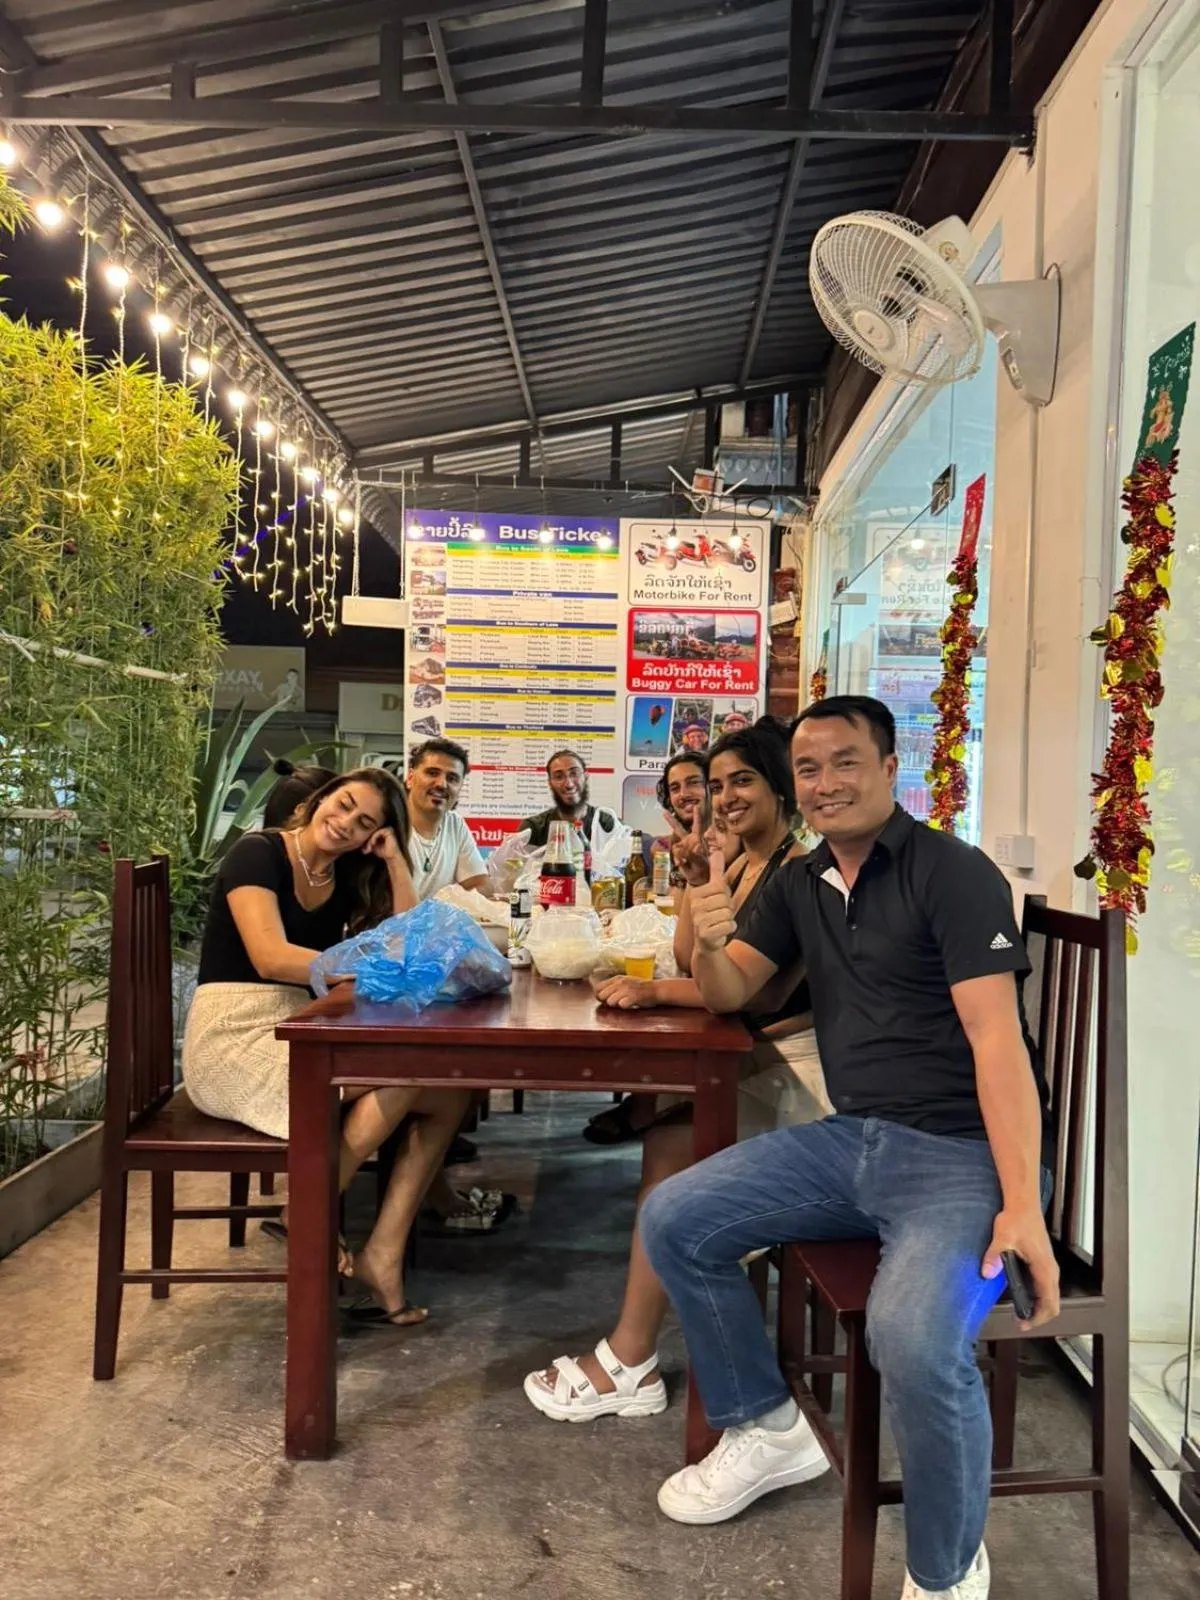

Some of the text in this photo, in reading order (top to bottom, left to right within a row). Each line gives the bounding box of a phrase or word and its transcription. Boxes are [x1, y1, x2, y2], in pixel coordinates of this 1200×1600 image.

[499, 525, 540, 540] Bus
[633, 590, 753, 602] Motorbike For Rent
[631, 678, 755, 691] Buggy Car For Rent
[381, 693, 404, 711] D
[638, 759, 667, 769] Para
